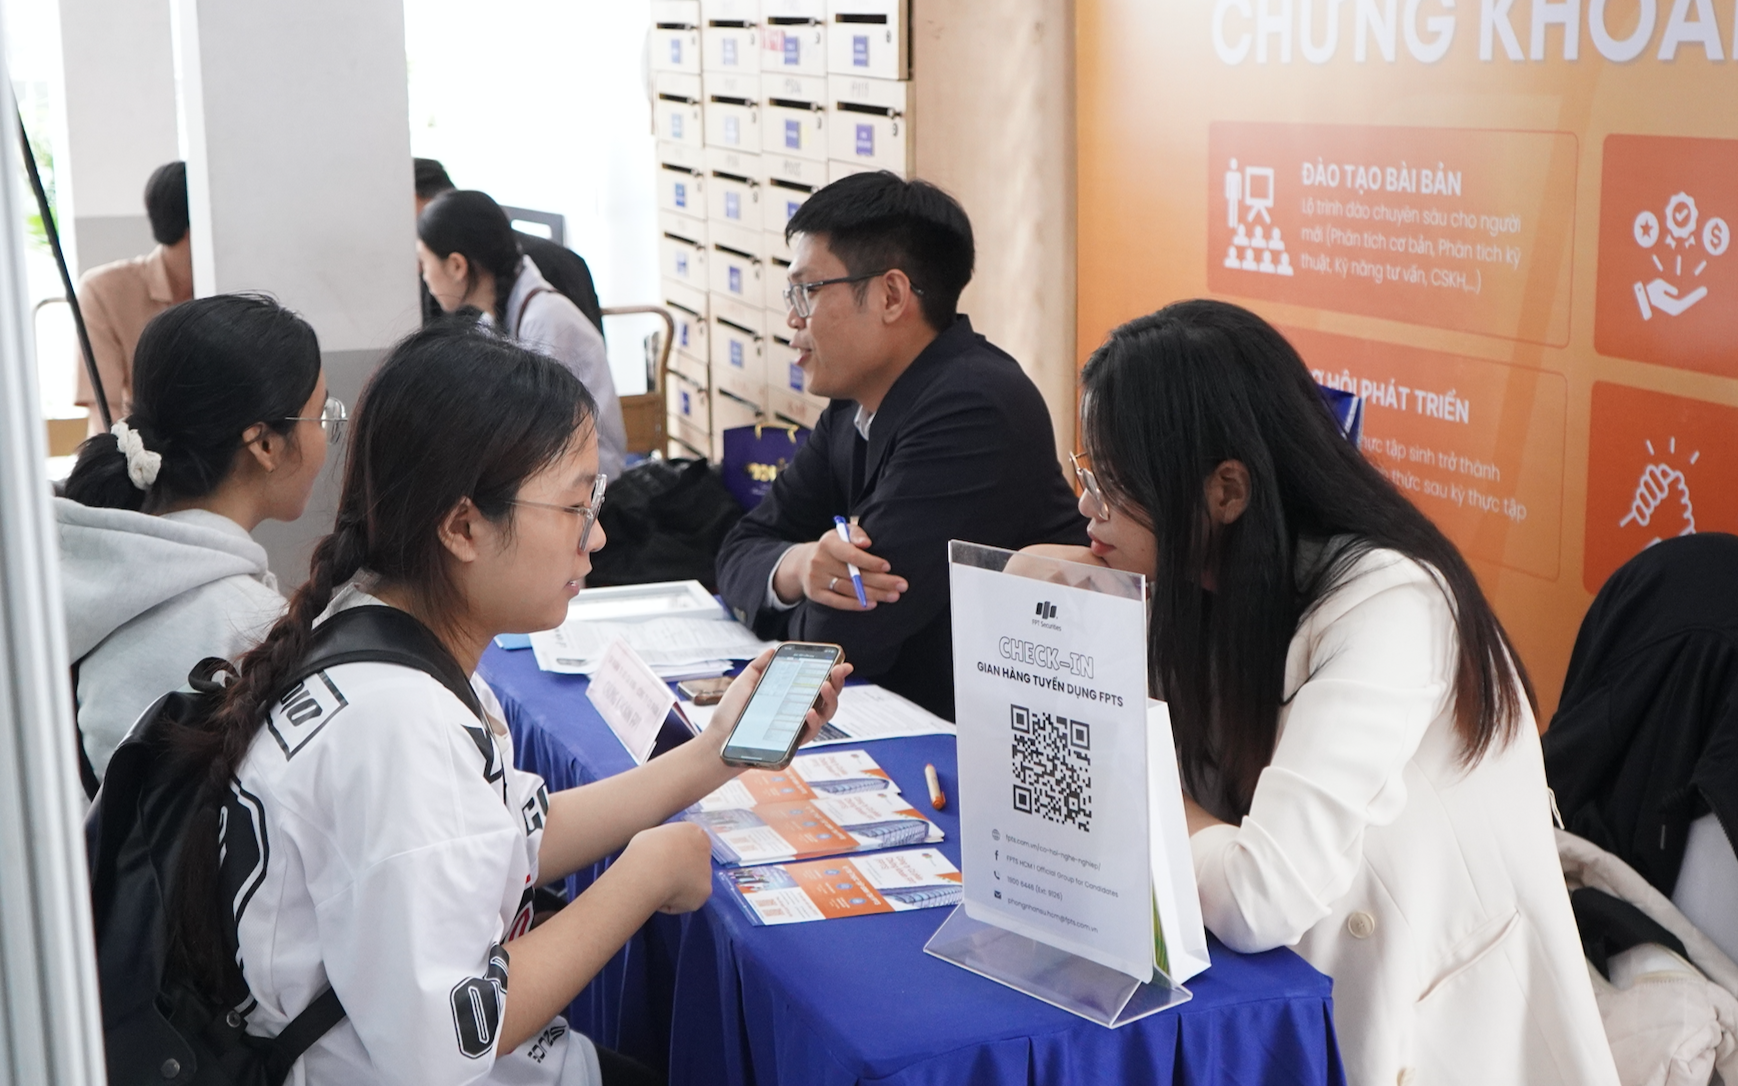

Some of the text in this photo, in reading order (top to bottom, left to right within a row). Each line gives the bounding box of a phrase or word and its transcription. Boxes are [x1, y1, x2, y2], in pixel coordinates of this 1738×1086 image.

[1302, 156, 1462, 196] ĐÀO TẠO BÀI BẢN
[1301, 197, 1521, 237] Lộ trình đào chuyên sâu cho người
[1301, 225, 1324, 243] mới
[1363, 231, 1386, 250] tích
[1389, 236, 1406, 252] cơ
[1438, 238, 1472, 259] Phân
[1476, 243, 1502, 262] tích
[1386, 264, 1402, 281] tư
[1361, 378, 1411, 412] PHÁT
[1414, 387, 1470, 425] TRIỂN
[1386, 439, 1407, 462] tập
[1409, 445, 1435, 465] sinh
[1438, 451, 1458, 471] trở
[1459, 456, 1501, 482] thành
[1423, 479, 1448, 499] sau
[1467, 489, 1501, 514] thực
[1503, 498, 1527, 523] tập
[1031, 619, 1062, 632] FPT Securities
[998, 635, 1095, 679] CHECK-IN
[977, 661, 1124, 708] GIAN HÀNG TUYỂN DỤNG FPTS
[1006, 854, 1019, 865] FPTS
[1019, 859, 1033, 870] HCM
[1036, 865, 1056, 877] Official
[1057, 871, 1075, 884] Group
[1075, 878, 1084, 886] for
[1084, 881, 1119, 898] Candidates
